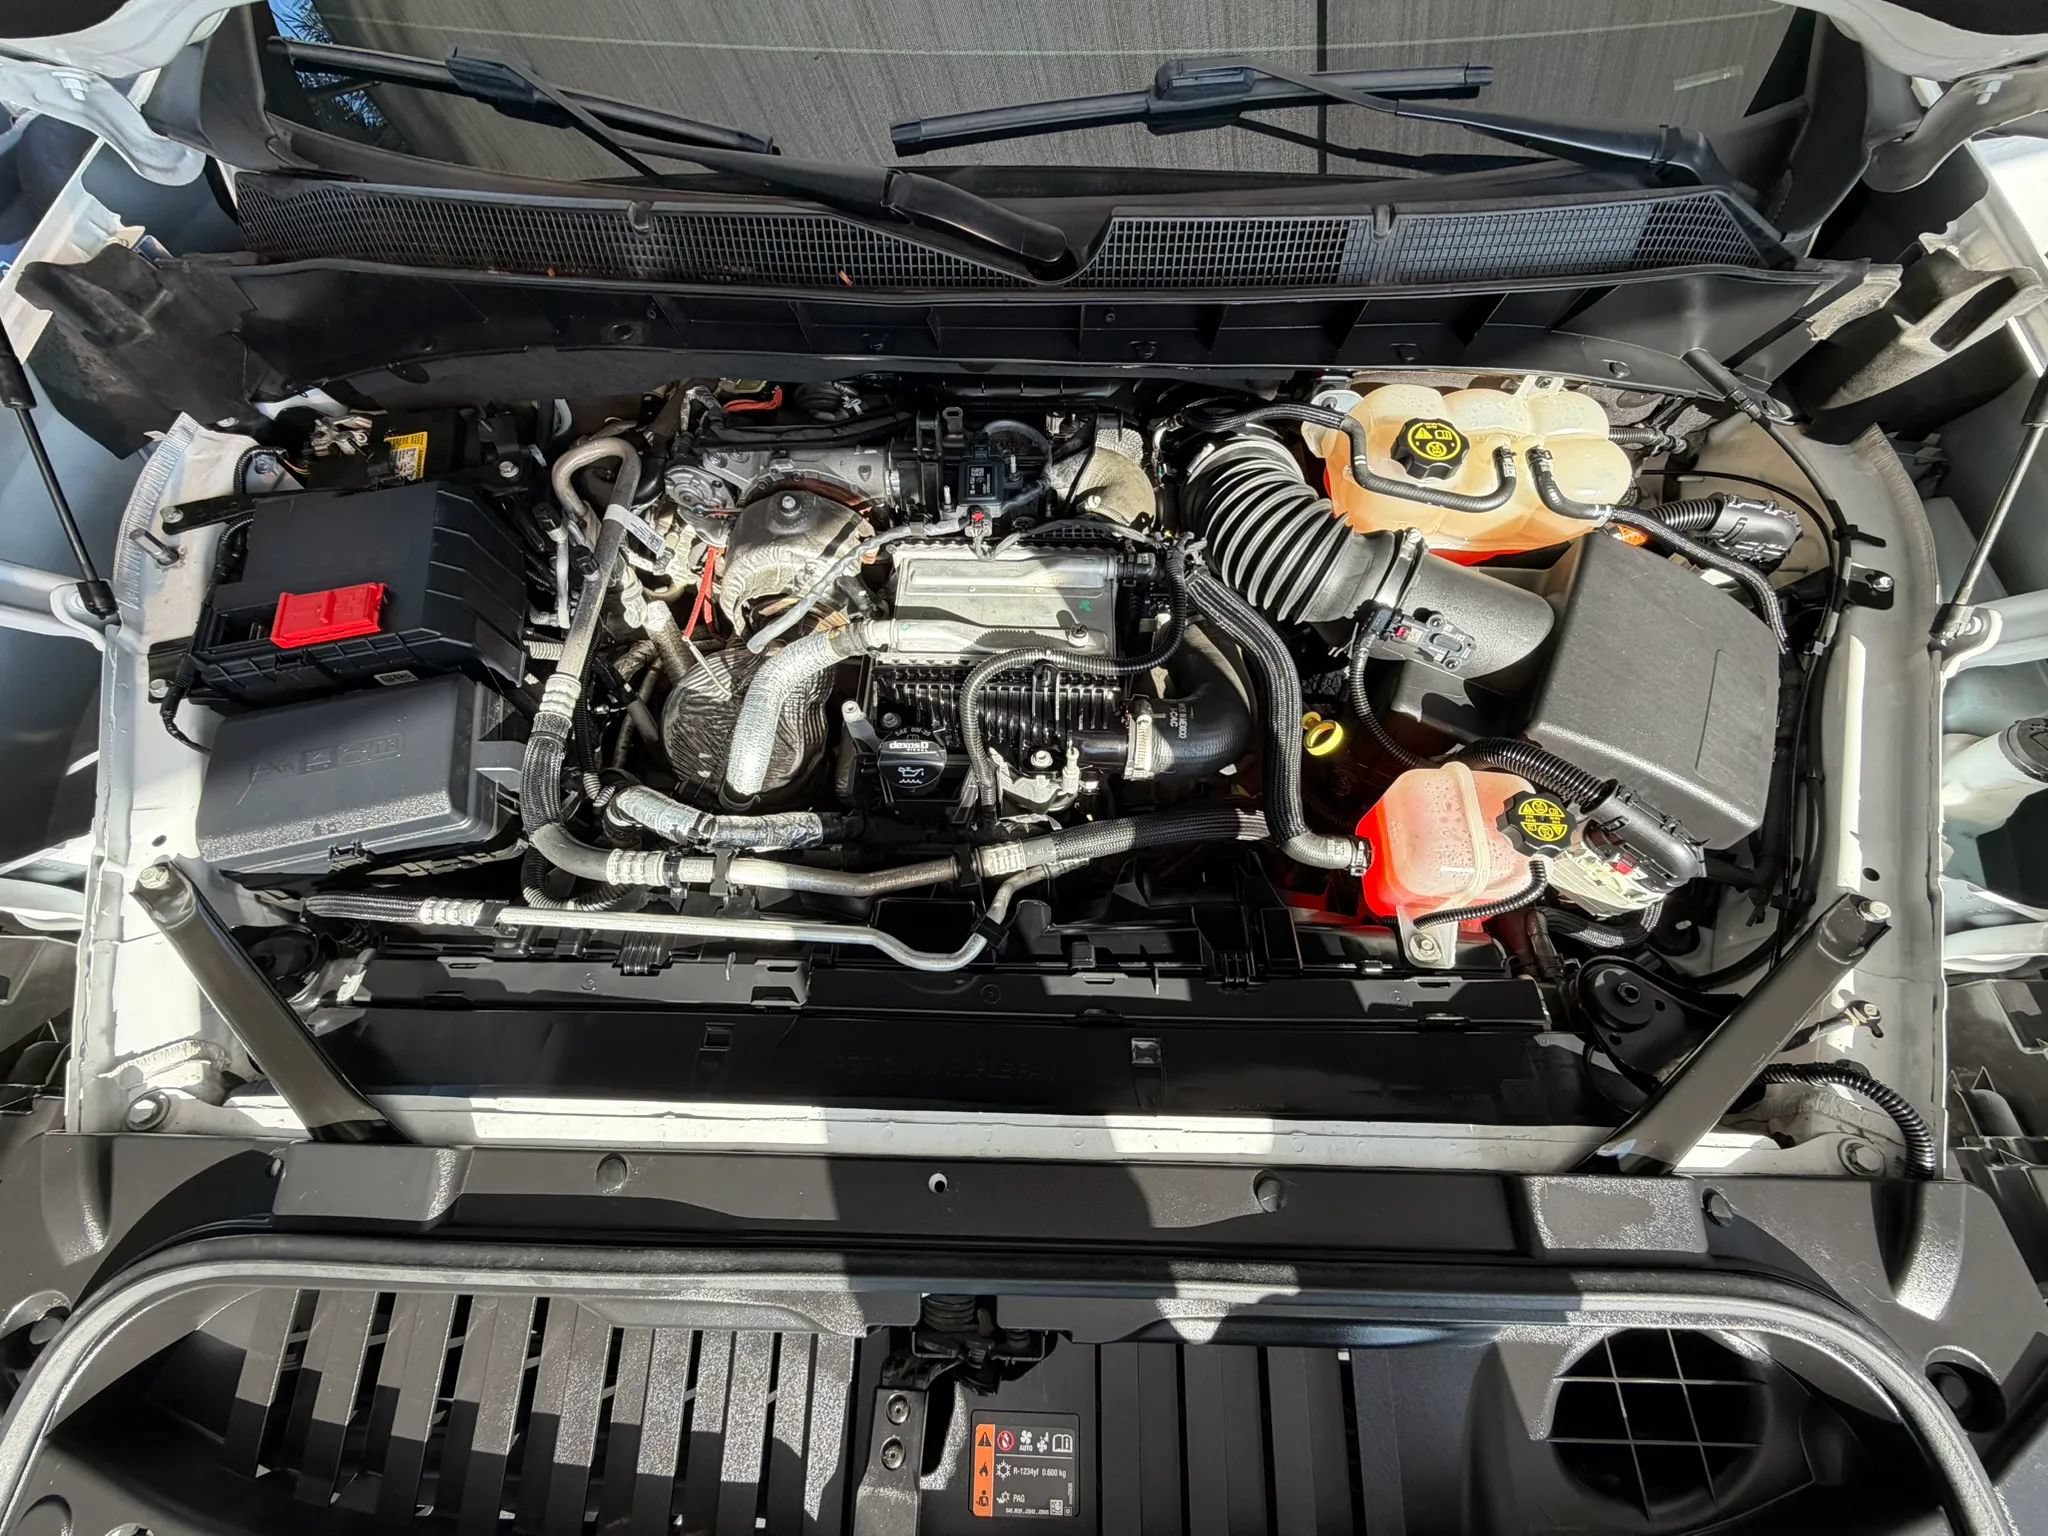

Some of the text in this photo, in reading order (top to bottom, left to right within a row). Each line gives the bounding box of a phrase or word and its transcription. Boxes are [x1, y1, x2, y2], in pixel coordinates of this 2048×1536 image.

[1013, 1467, 1039, 1478] R-1234yf
[1058, 1468, 1067, 1479] kg
[1012, 1493, 1025, 1503] PAG
